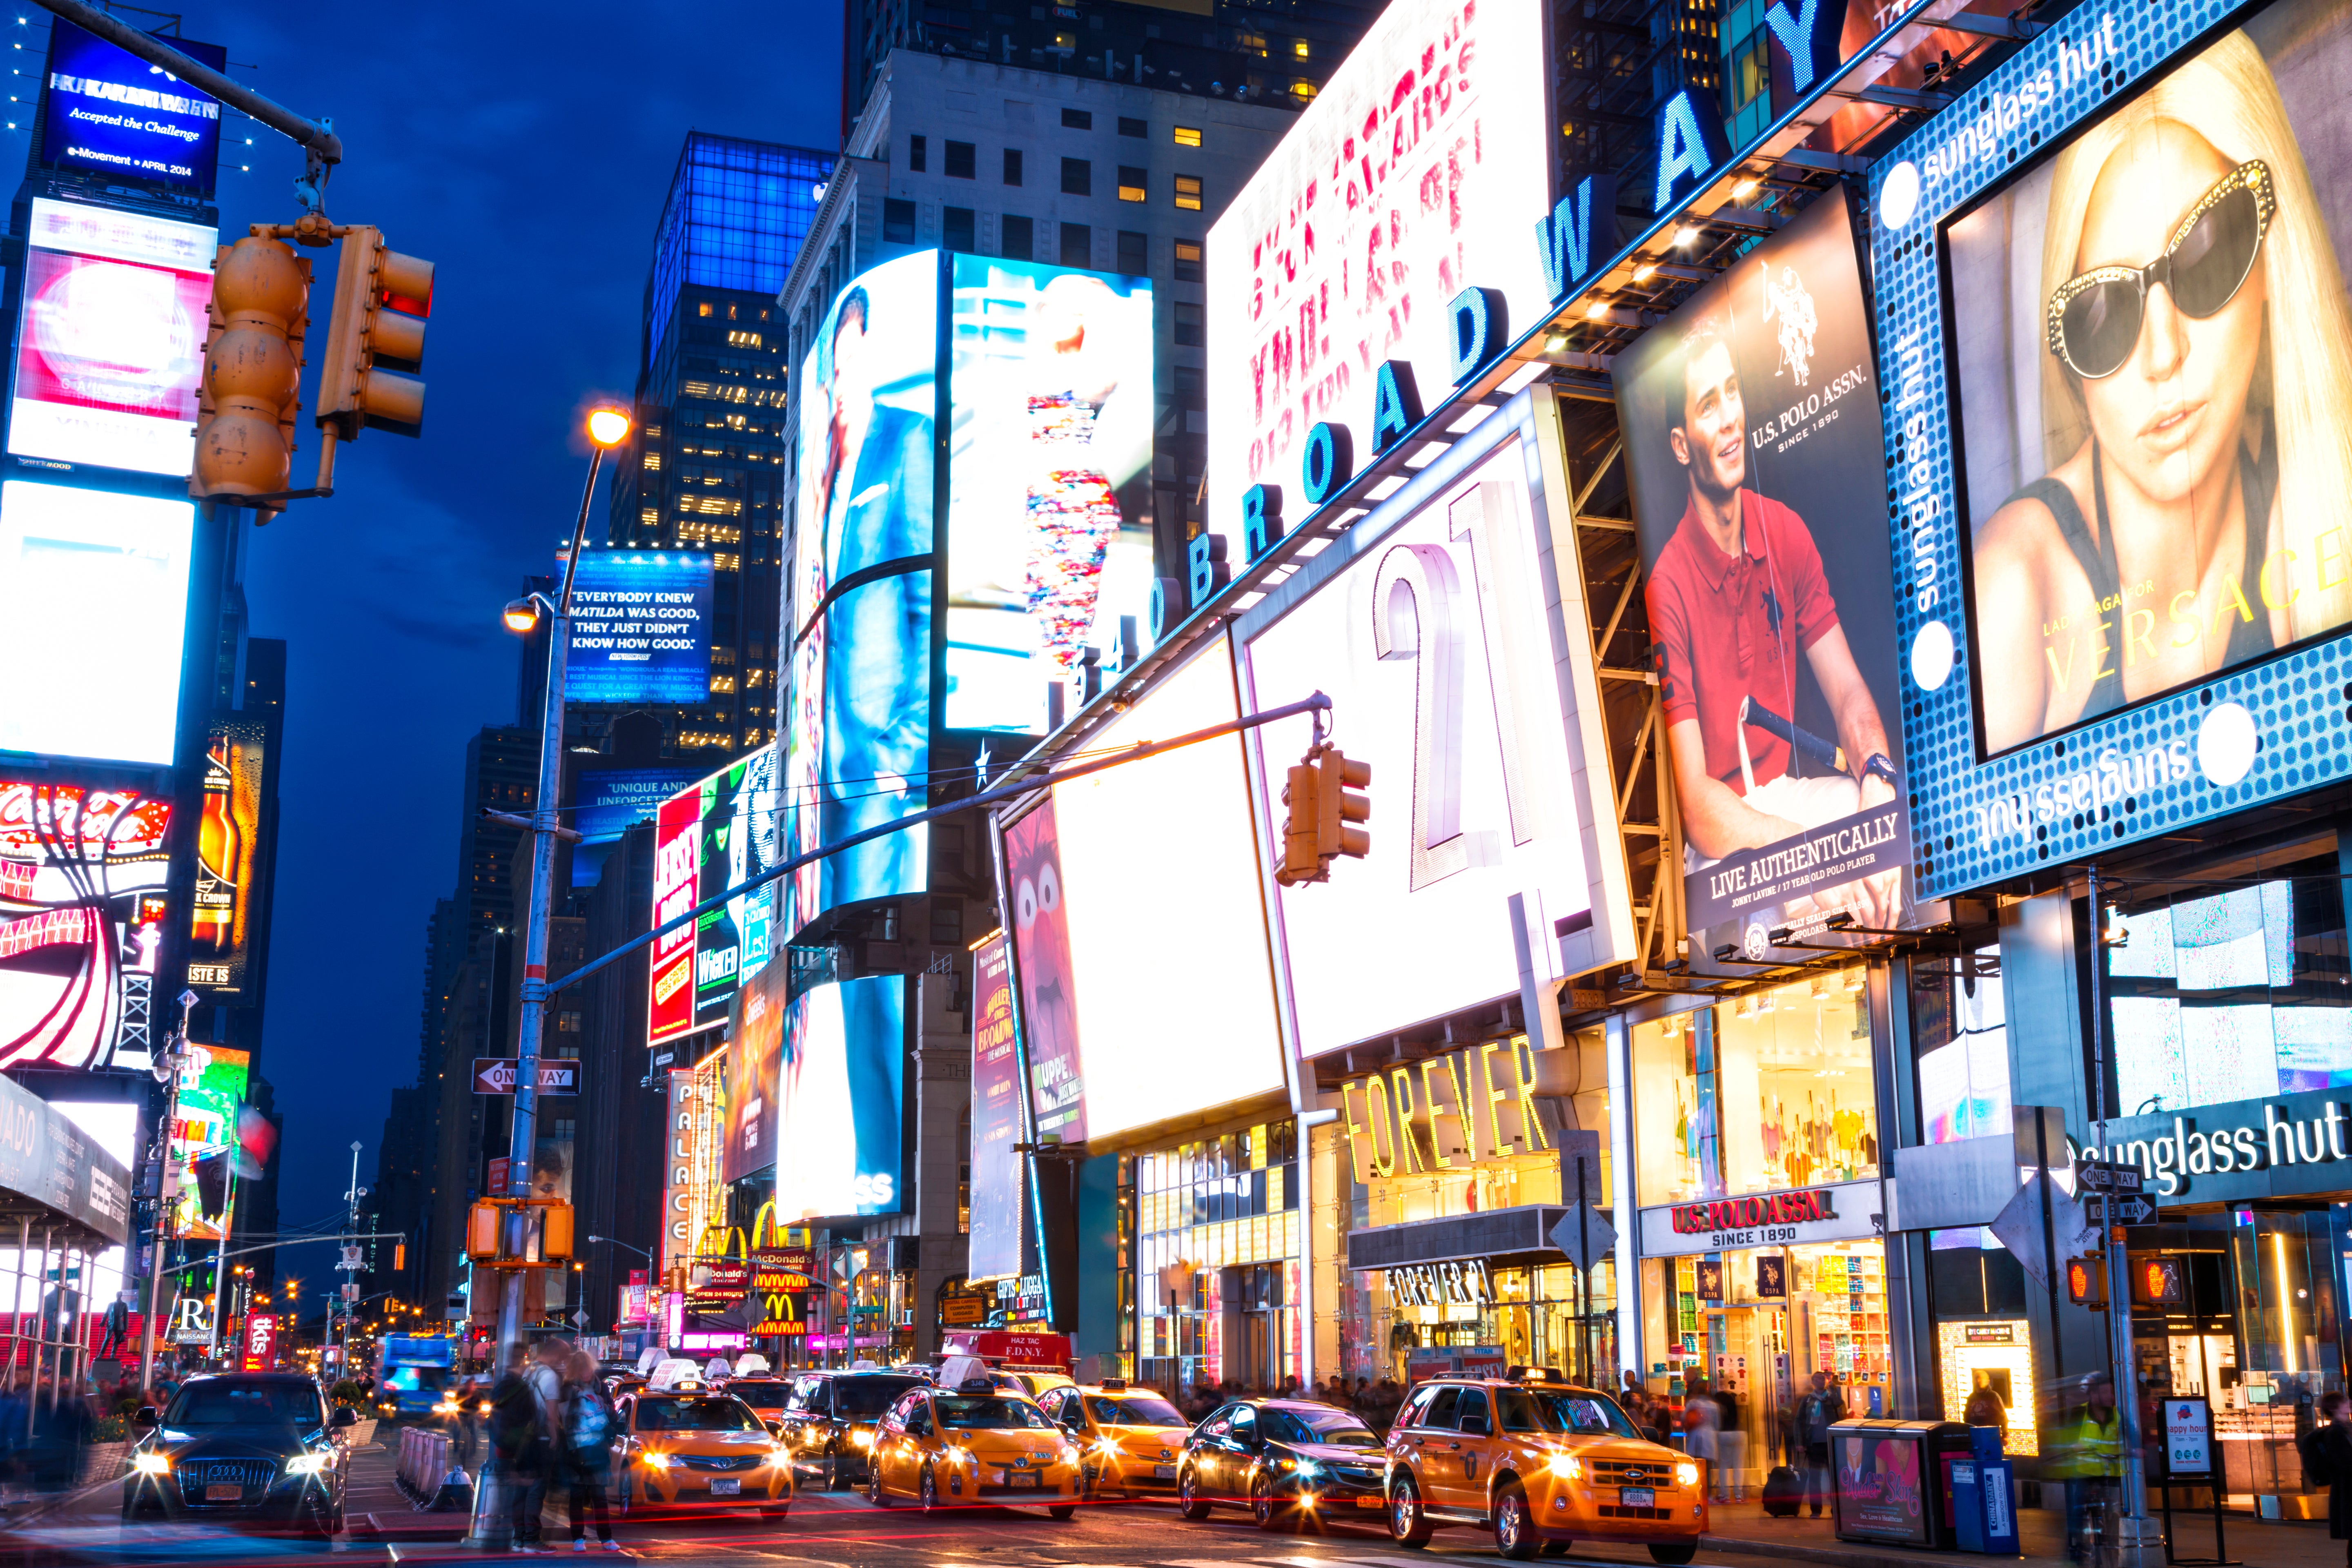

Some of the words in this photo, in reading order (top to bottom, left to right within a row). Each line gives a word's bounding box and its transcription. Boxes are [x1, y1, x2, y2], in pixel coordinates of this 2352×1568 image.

[1057, 7, 1077, 19] FUEL
[1924, 68, 2055, 189] sunglass
[2058, 12, 2118, 89] hut
[69, 108, 122, 126] Accepted
[124, 118, 142, 129] the
[145, 121, 199, 142] Challenge
[142, 160, 167, 172] APRIL
[170, 165, 192, 176] 2014
[1189, 0, 1817, 609] BROADWAY
[1894, 324, 1926, 410] hut
[1752, 423, 1778, 450] U.S.
[1779, 394, 1820, 436] POLO
[1822, 365, 1867, 412] ASSN.
[1778, 429, 1809, 453] SINCE
[1812, 409, 1840, 432] 1890
[1902, 412, 1940, 613] sunglass
[572, 591, 653, 603] "EVERYBODY
[655, 592, 695, 603] KNEW
[2083, 592, 2124, 620] GAGA
[2127, 578, 2155, 604] FOR
[569, 607, 624, 617] MATILDA
[628, 608, 656, 618] WAS
[658, 609, 699, 620] GOOD,
[2045, 525, 2349, 695] VERSACE
[575, 623, 609, 633] THEY
[612, 623, 642, 633] JUST
[645, 624, 689, 634] DIDN'T
[572, 638, 615, 648] KNOW
[617, 638, 650, 648] HOW
[653, 639, 695, 649] GOOD."
[1373, 481, 1532, 893] 21
[608, 783, 657, 793] "UNIQUE
[661, 782, 688, 791] AND
[2037, 740, 2189, 822] sunglass
[1976, 795, 2032, 852] hut
[655, 823, 699, 903] JERSEY
[1710, 862, 1746, 900] LIVE
[1750, 812, 1899, 888] AUTHENTICALLY
[1732, 892, 1752, 909] JONNY
[1753, 884, 1777, 903] LAVINE
[1783, 880, 1791, 891] 17
[1792, 874, 1811, 890] YEAR
[1811, 869, 1826, 883] OLD
[1826, 864, 1846, 880] POLO
[1846, 853, 1876, 875] PLAYER
[203, 893, 231, 903] CROWN
[1806, 910, 1831, 924] SEALED
[1832, 904, 1852, 915] SINCE
[217, 968, 229, 982] IS
[670, 962, 686, 980] CROWD
[698, 946, 737, 985] WICKED
[659, 984, 671, 998] GOES
[994, 1007, 1004, 1020] OVER
[995, 1043, 1011, 1060] MUSICAL
[493, 1070, 514, 1083] ON
[1000, 1080, 1011, 1093] ALLEN
[1341, 1033, 1549, 1184] FOREVER
[1042, 1114, 1064, 1130] THEATRES
[2265, 1102, 2350, 1165] hut
[673, 1085, 693, 1239] PALACE
[2087, 1170, 2106, 1183] ONE
[2116, 1173, 2134, 1185] WAY
[1671, 1205, 1703, 1233] U.S.
[1708, 1197, 1760, 1230] POLO
[1766, 1190, 1826, 1224] ASSN.
[2096, 1205, 2115, 1217] OE
[2124, 1204, 2145, 1216] WAY
[1712, 1231, 1753, 1247] SINCE
[1760, 1227, 1796, 1242] 1890
[752, 1255, 812, 1264] McDonald's
[629, 1285, 647, 1294] JERSEY
[998, 1278, 1016, 1299] GIFTS
[1385, 1263, 1468, 1308] FOREVER
[1468, 1260, 1491, 1302] 21
[633, 1294, 646, 1303] BOYS
[178, 1298, 212, 1330] R
[252, 1318, 272, 1354] tkts
[1006, 1346, 1044, 1356] F.D.N.Y.
[1987, 1479, 1997, 1527] CHINADAILY
